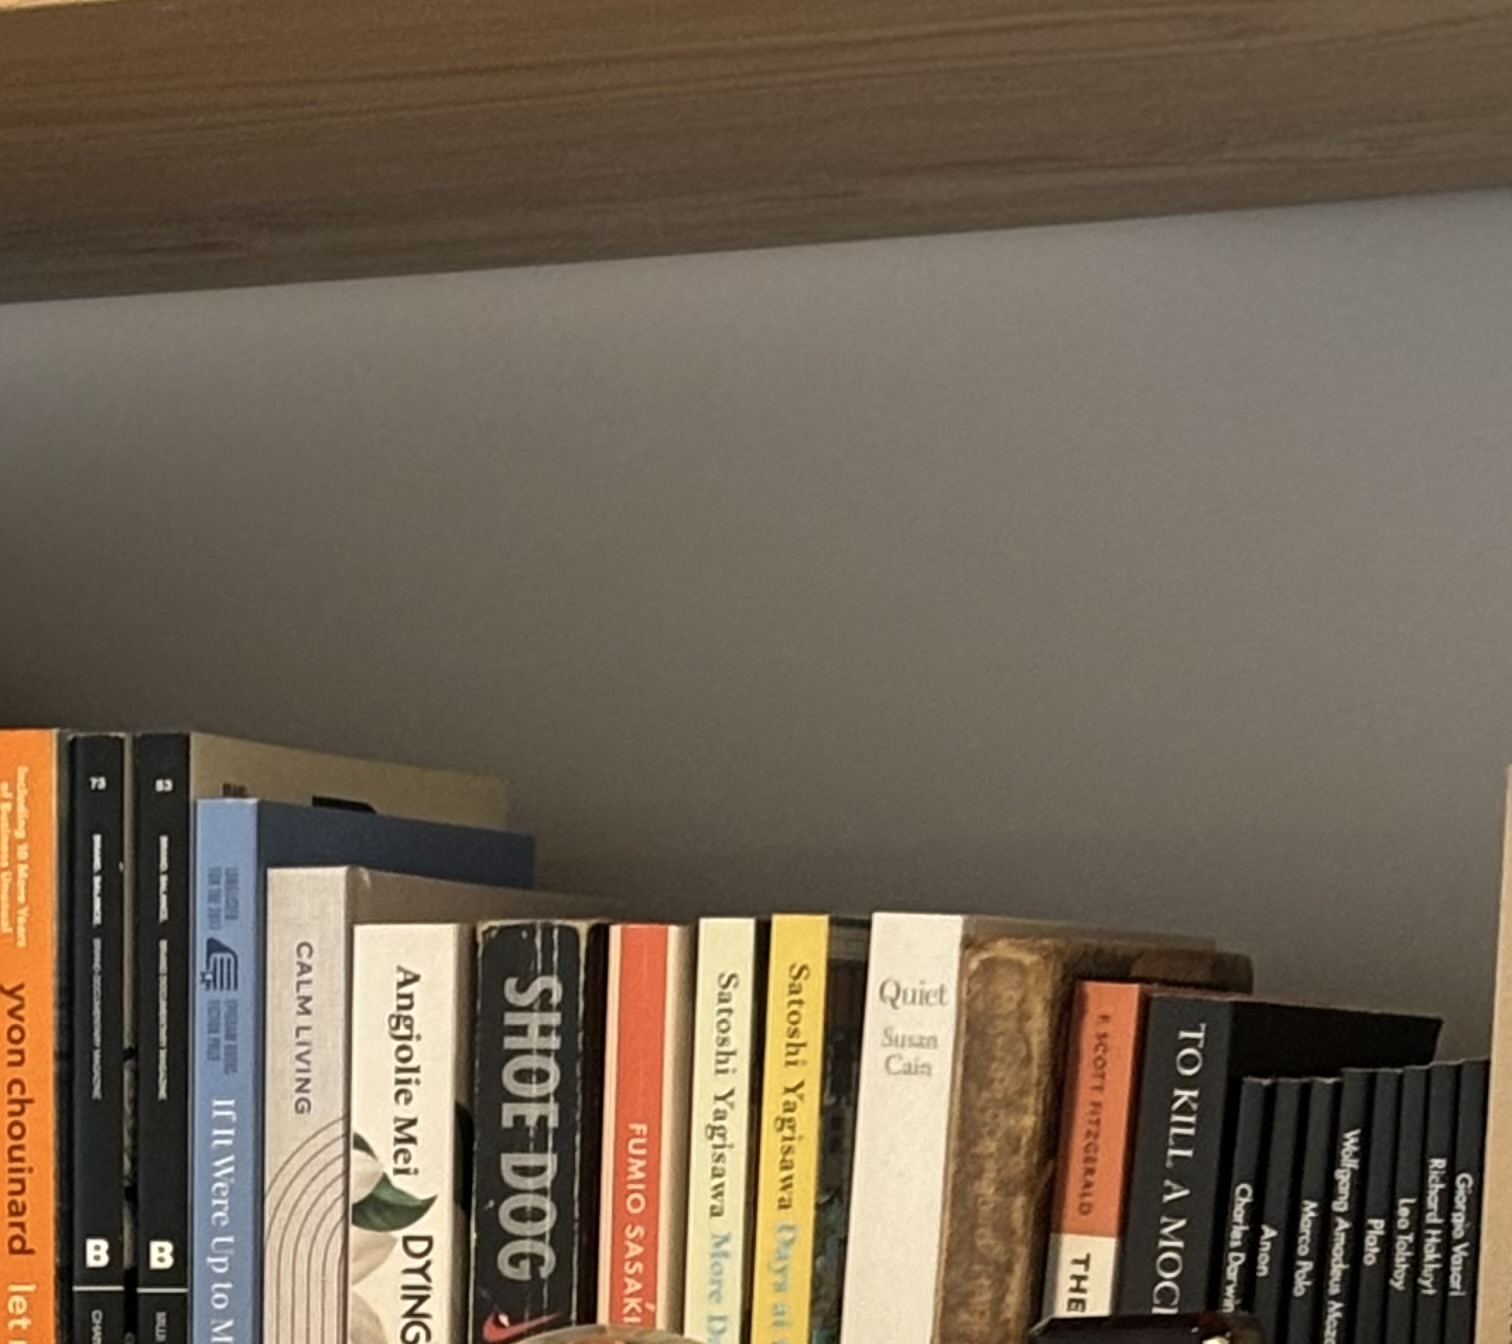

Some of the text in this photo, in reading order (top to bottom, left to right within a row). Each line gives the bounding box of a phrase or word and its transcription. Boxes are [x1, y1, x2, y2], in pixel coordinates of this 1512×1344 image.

[0, 982, 27, 1068] yvon
[294, 941, 313, 1115] CALM LIVING
[784, 964, 811, 1068] Satoshi
[878, 978, 948, 1010] Quiet
[387, 965, 422, 1177] Angjolie Mei
[881, 1026, 939, 1050] Susan
[884, 1053, 933, 1078] Cain
[1093, 1030, 1110, 1094] SCOTT
[1175, 1022, 1207, 1077] TO
[212, 1099, 237, 1120] If
[212, 1128, 237, 1149] It
[497, 974, 563, 1282] SHOE DOG
[704, 971, 739, 1305] Satoshi Yagisawa More
[775, 1079, 806, 1211] Yagisawa
[1165, 1088, 1200, 1169] KILL
[5, 1078, 36, 1256] chouinard
[211, 1156, 235, 1228] Were
[1079, 1101, 1104, 1217] FITZGERALD
[1162, 1179, 1192, 1204] A
[1332, 1128, 1361, 1212] Wolfgang
[86, 1238, 110, 1269] B
[149, 1240, 175, 1270] B
[206, 1235, 236, 1275] Up
[623, 1123, 648, 1324] FUMIO SASAKI
[1222, 1183, 1253, 1313] Charles Darwin
[1255, 1223, 1279, 1277] Anon
[1292, 1200, 1319, 1298] Marco Polo
[1327, 1216, 1352, 1296] Amadeus
[1362, 1218, 1385, 1267] Plato
[1388, 1197, 1417, 1292] Leo Tolstoy
[1416, 1157, 1447, 1296] Richard Hakluyt
[1447, 1172, 1473, 1297] Giorgio Vasari
[7, 1283, 37, 1329] let
[210, 1280, 234, 1310] to
[1067, 1253, 1091, 1313] THE
